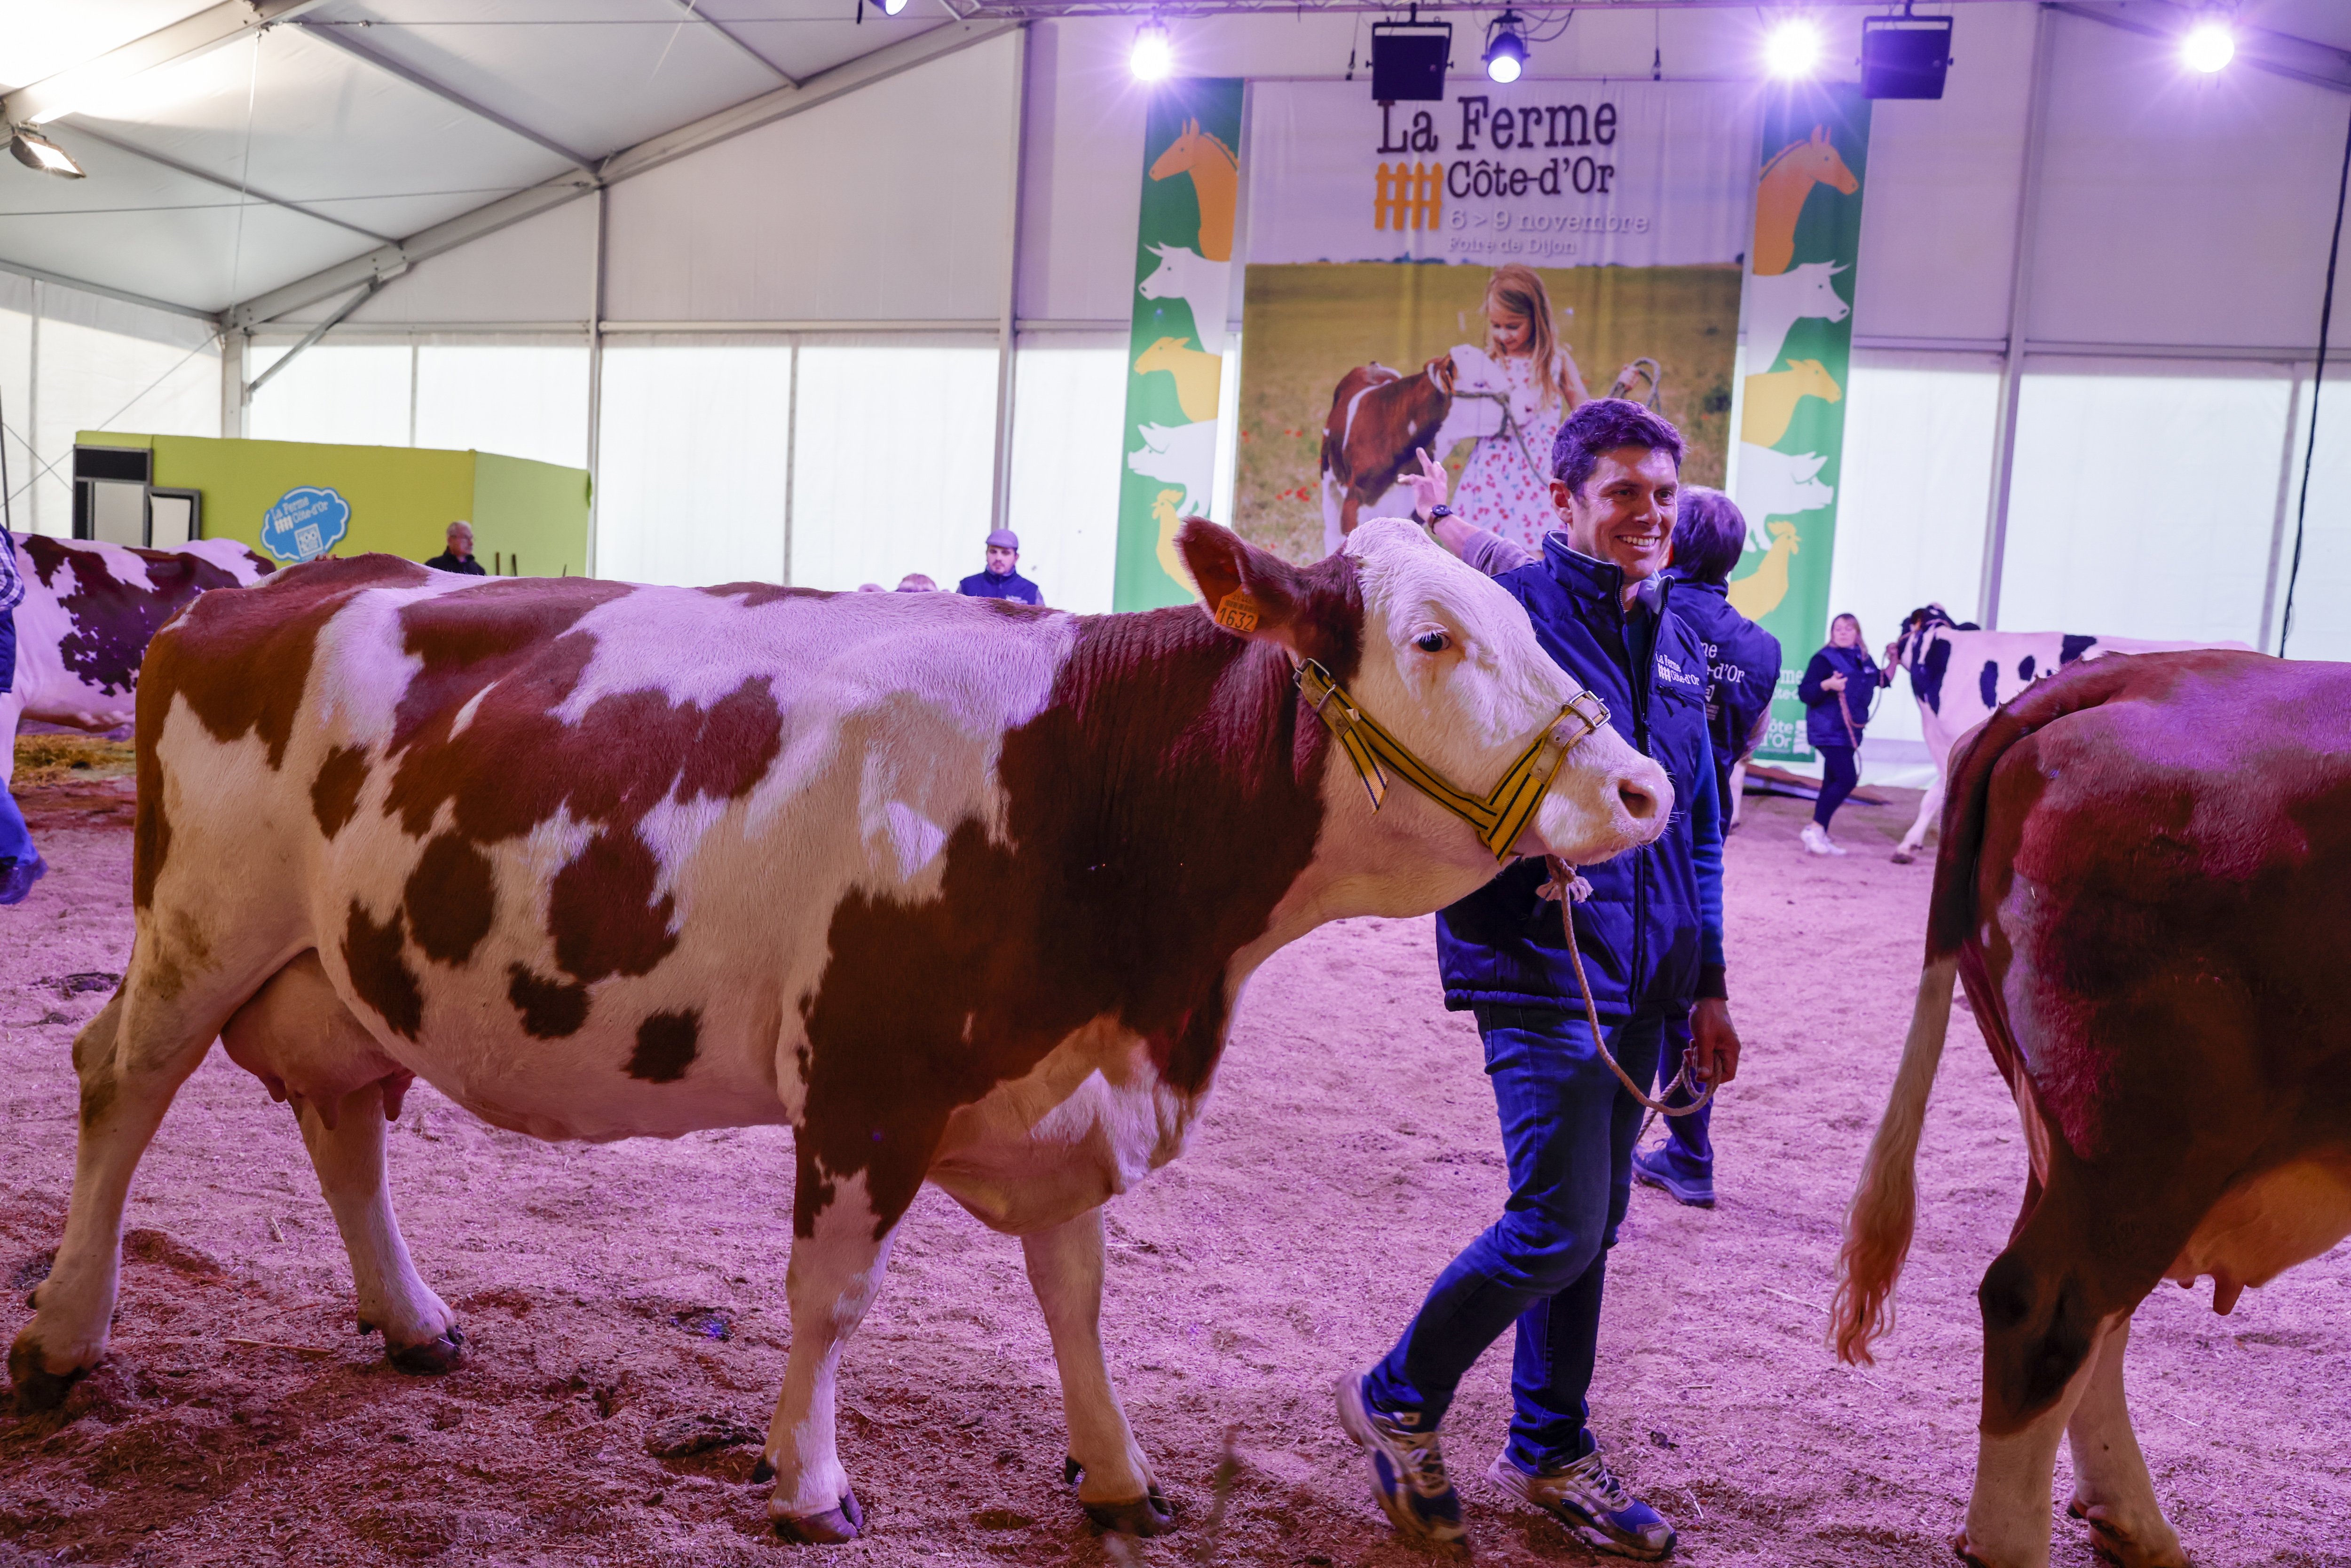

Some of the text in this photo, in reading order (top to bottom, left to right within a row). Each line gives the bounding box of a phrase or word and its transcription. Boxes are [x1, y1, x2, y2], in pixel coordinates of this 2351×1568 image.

[1377, 95, 1617, 153] La Ferme
[1447, 156, 1615, 198] Côte-d'Or
[1450, 210, 1467, 231] 6
[1495, 210, 1511, 231] 9
[1518, 213, 1649, 233] novembre
[1448, 238, 1576, 257] Foire de Dijon
[270, 508, 283, 520] La
[1219, 607, 1254, 631] 1632
[1655, 651, 1682, 673] La Ferme
[1768, 718, 1794, 734] ôte
